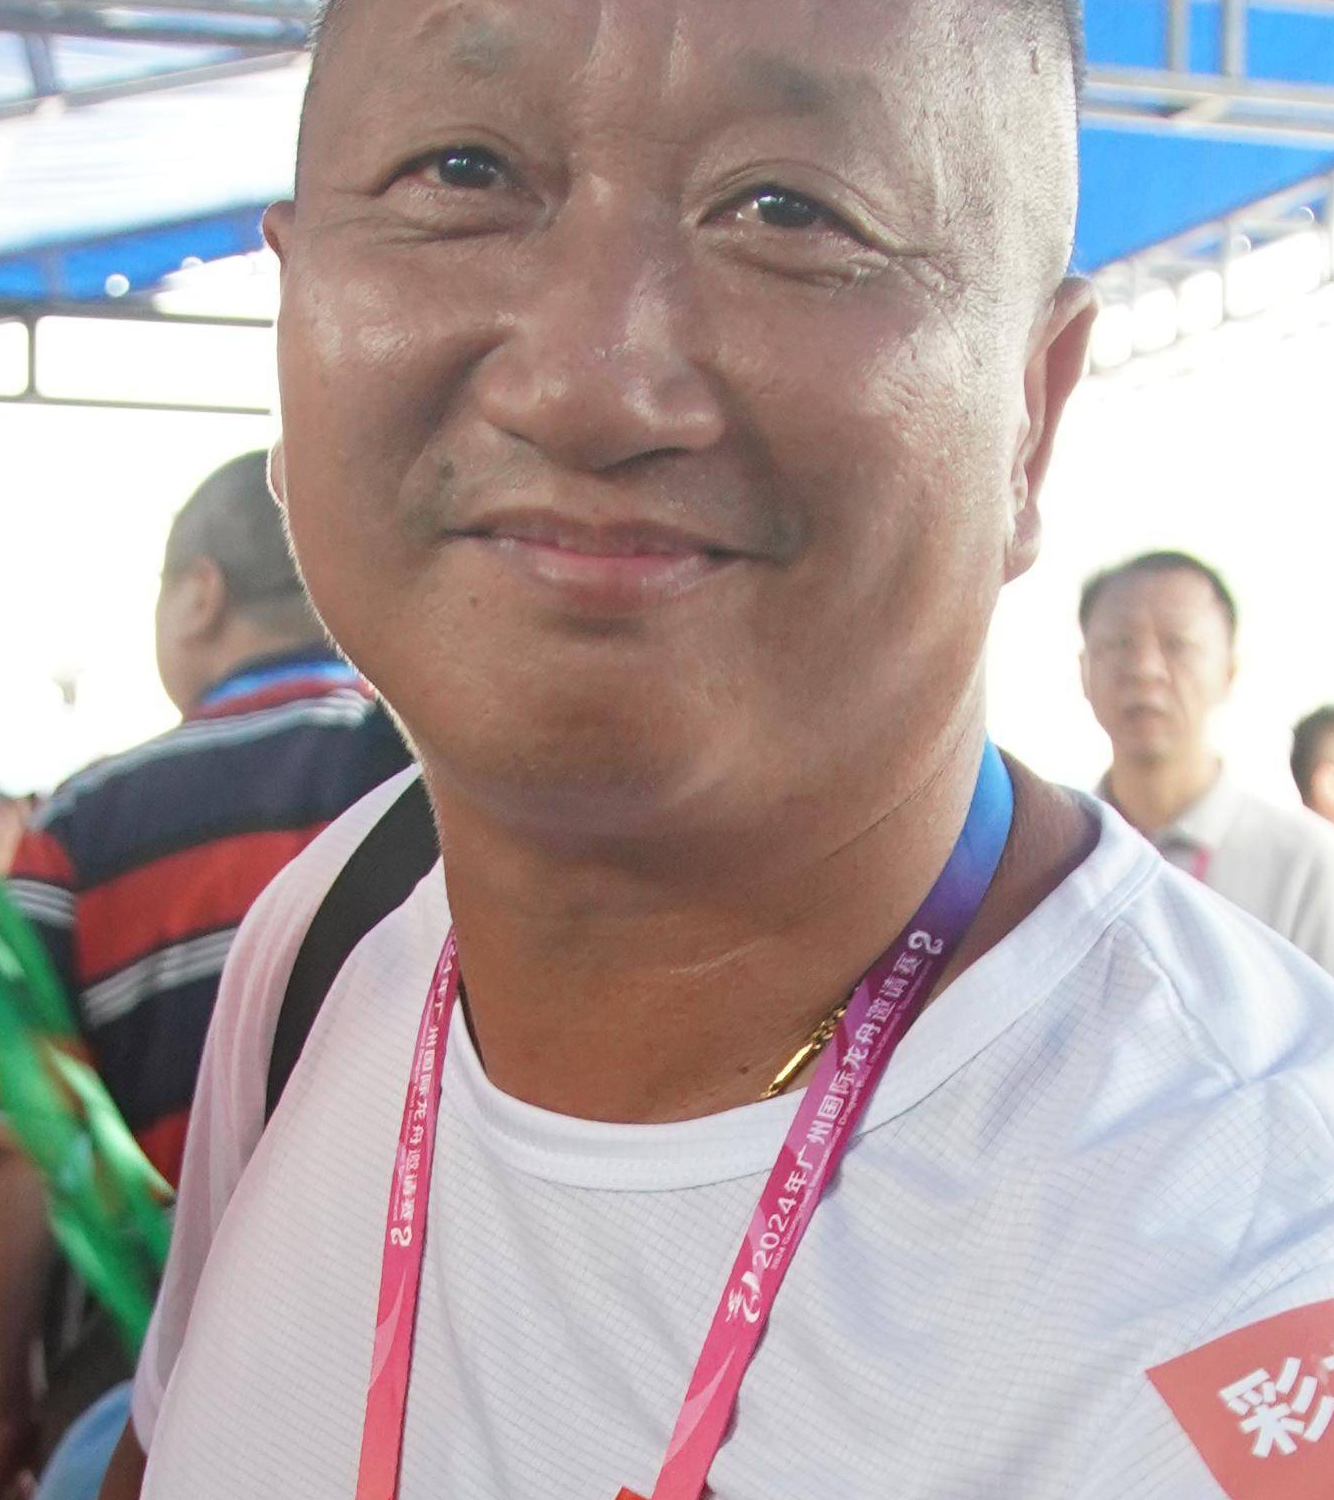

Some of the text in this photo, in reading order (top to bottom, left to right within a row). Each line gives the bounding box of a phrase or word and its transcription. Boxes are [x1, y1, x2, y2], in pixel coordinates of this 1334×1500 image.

[755, 950, 923, 1269] 2024年广州国际龙舟邀请赛
